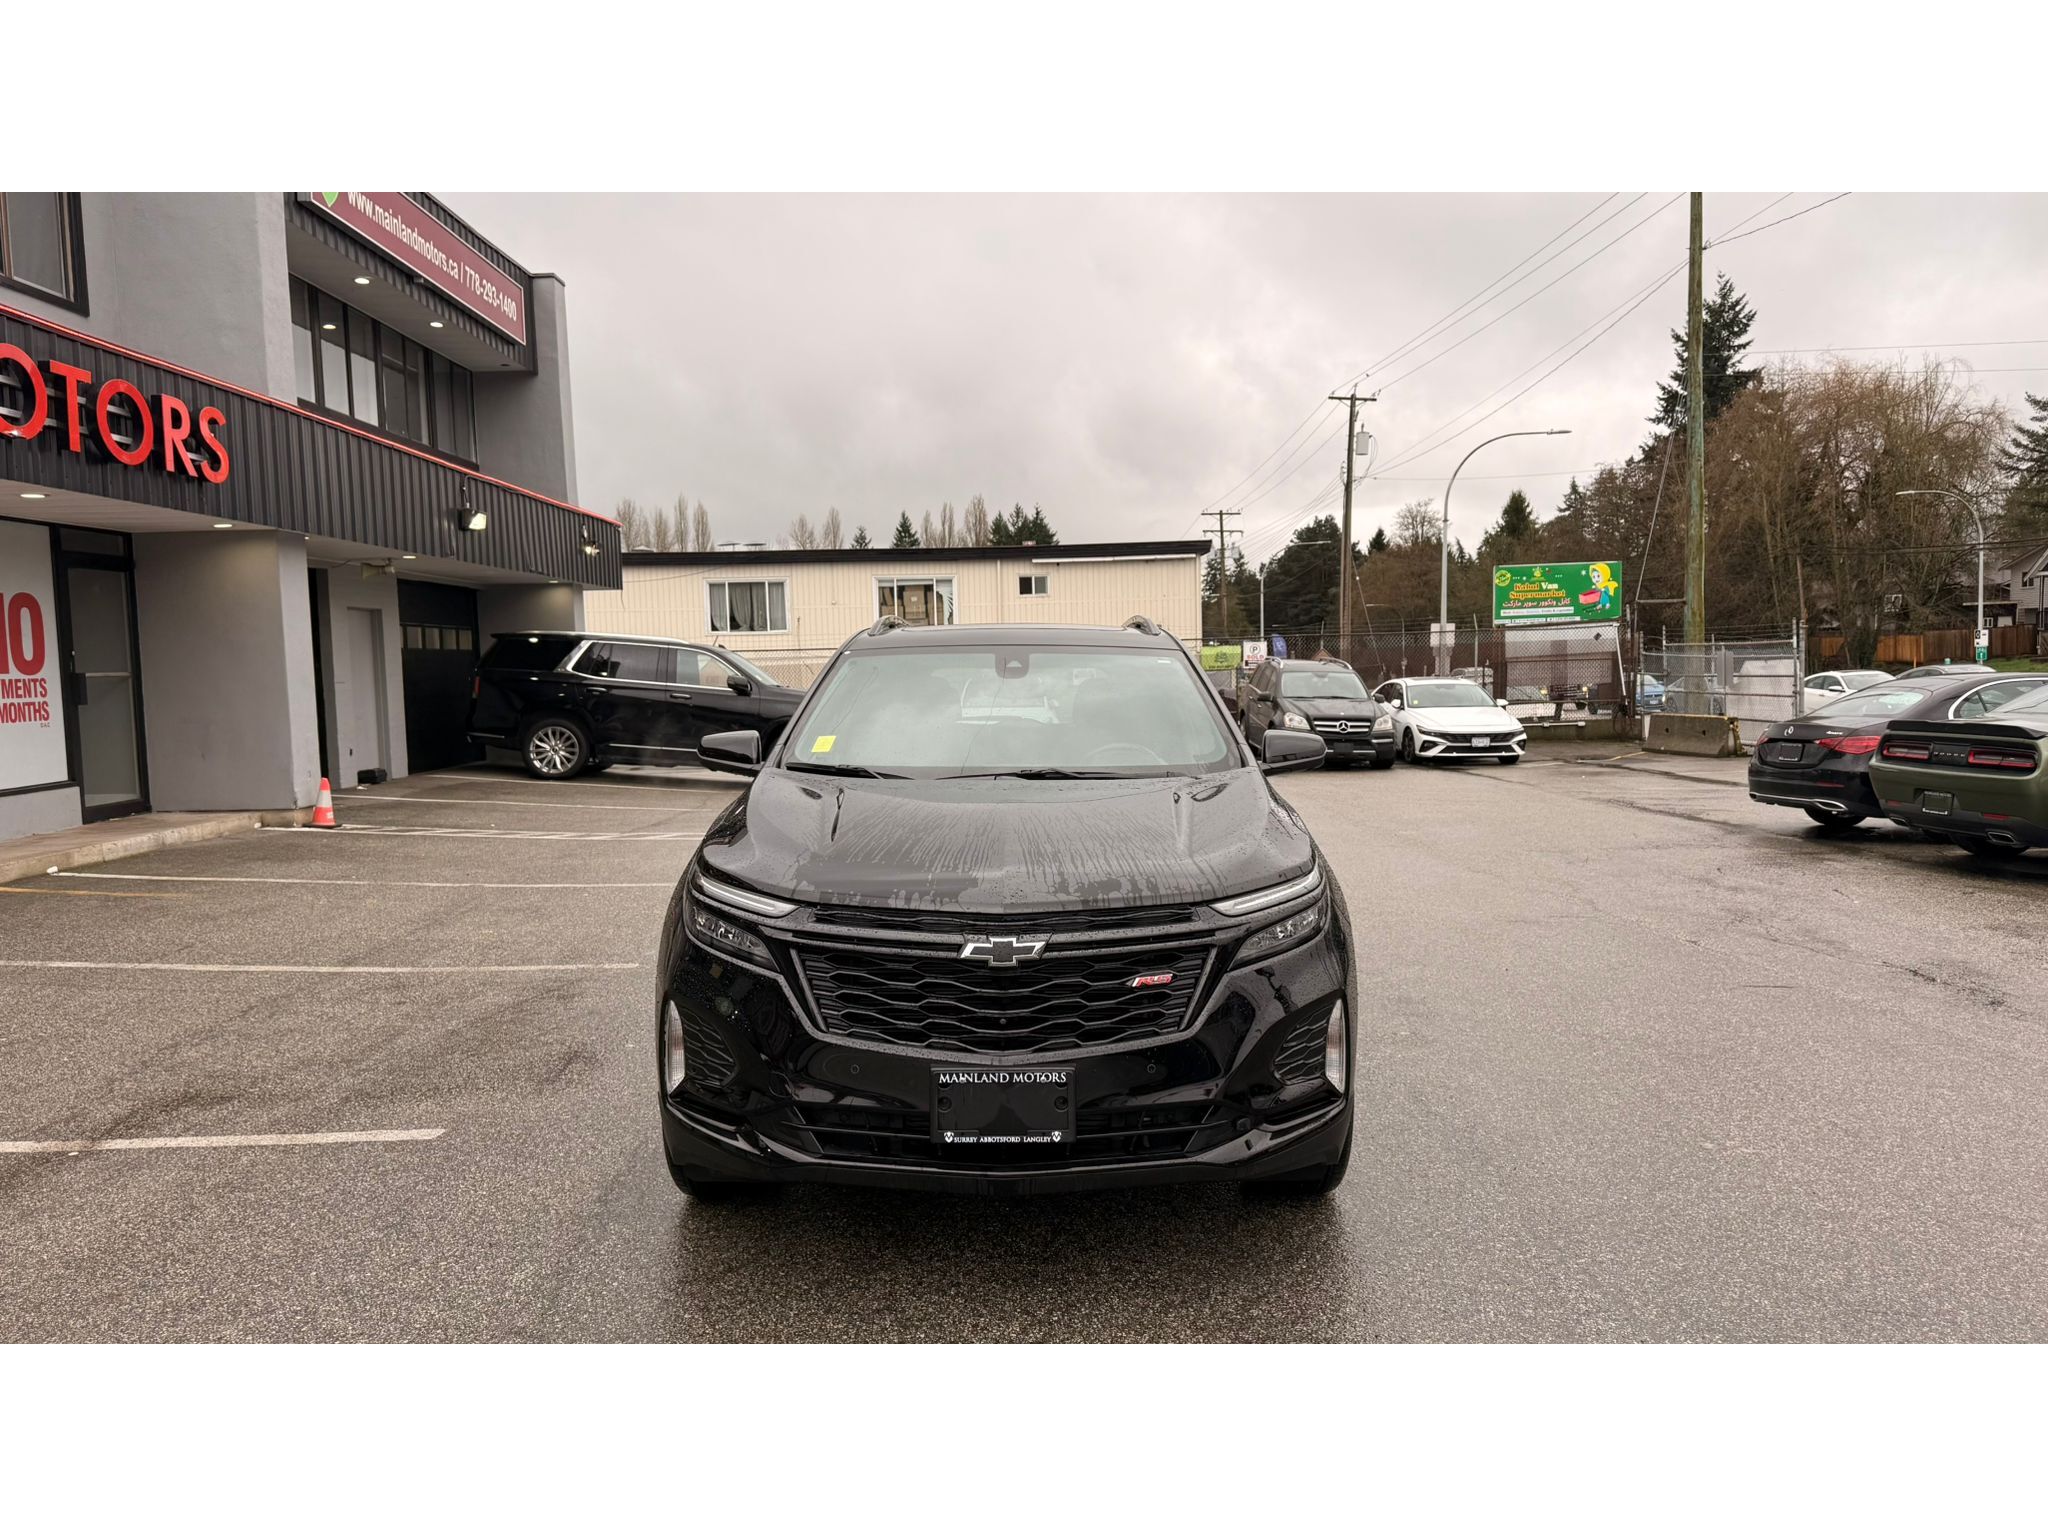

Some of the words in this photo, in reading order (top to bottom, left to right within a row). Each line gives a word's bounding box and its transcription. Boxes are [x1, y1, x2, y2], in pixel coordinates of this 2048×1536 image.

[347, 192, 459, 280] www.mainlandmotors.ca
[465, 265, 517, 322] 778-293-1400
[1541, 582, 1558, 590] Van
[1510, 590, 1565, 599] Supermarket
[0, 592, 45, 676] O
[0, 678, 48, 700] MENTS
[1131, 974, 1173, 988] RS
[939, 1072, 1009, 1083] MAINLAND
[1012, 1072, 1067, 1083] MOTORS
